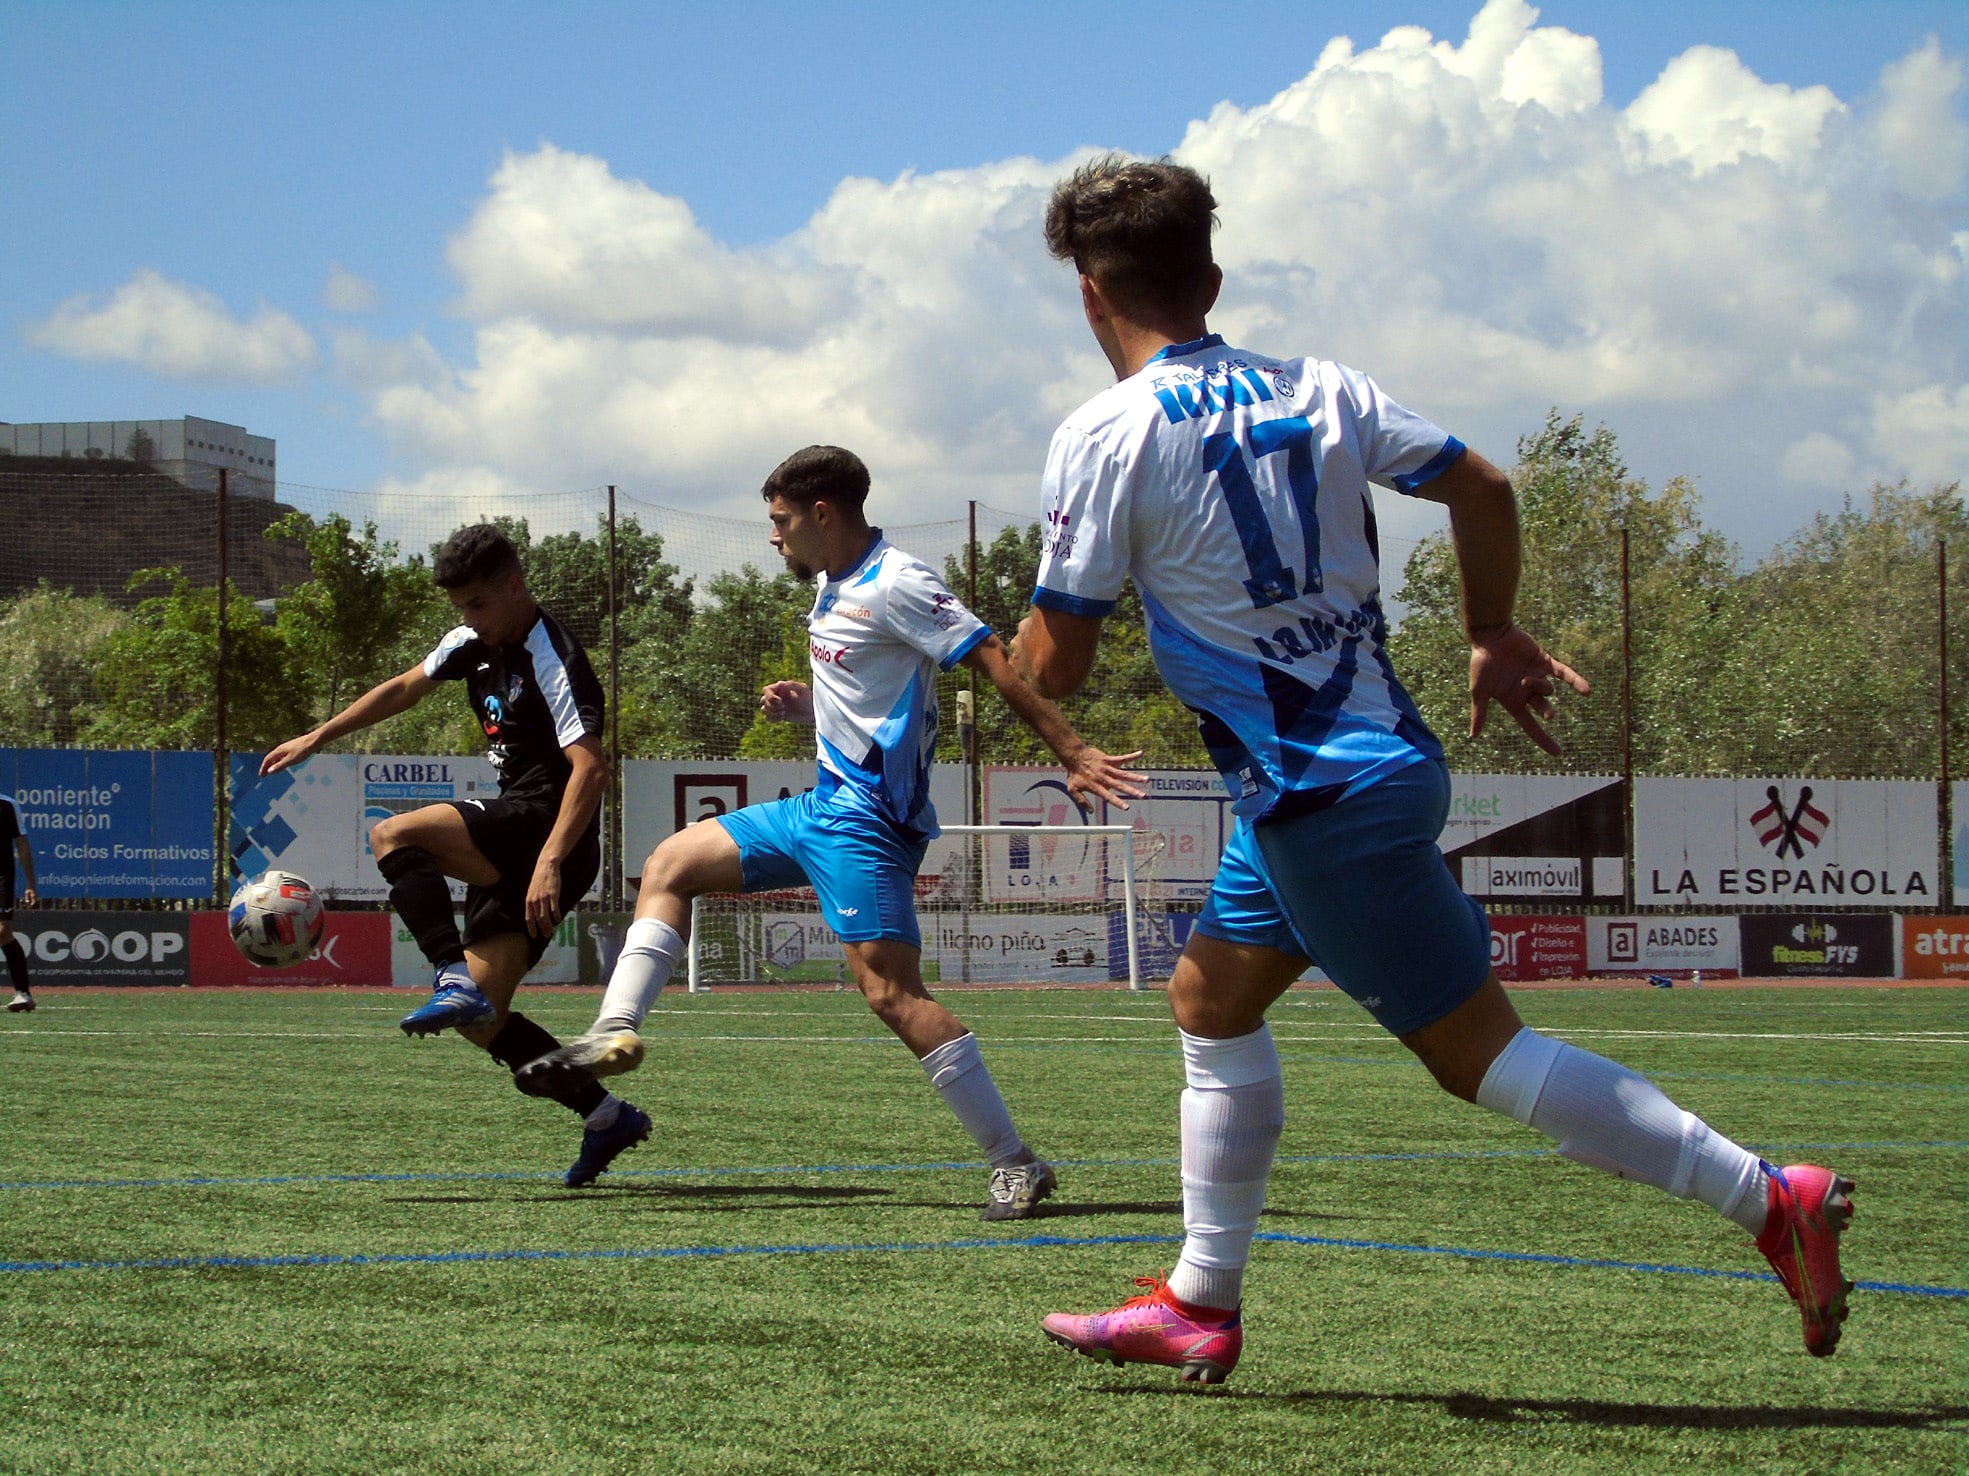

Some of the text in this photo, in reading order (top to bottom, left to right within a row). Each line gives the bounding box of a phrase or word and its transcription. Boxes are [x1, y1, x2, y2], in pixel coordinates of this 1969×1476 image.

[1203, 415, 1324, 609] 17
[364, 763, 454, 782] CARBEL
[1151, 776, 1208, 791] TELEVISIÓN
[1453, 793, 1501, 816] rket
[23, 809, 111, 829] rmación
[54, 844, 210, 860] Ciclos Formativos
[1492, 863, 1579, 888] aximóvil
[1652, 862, 1928, 895] LA ESPAÑOLA
[1000, 930, 1047, 956] piña
[1615, 932, 1629, 953] a
[1646, 928, 1718, 946] ABADES
